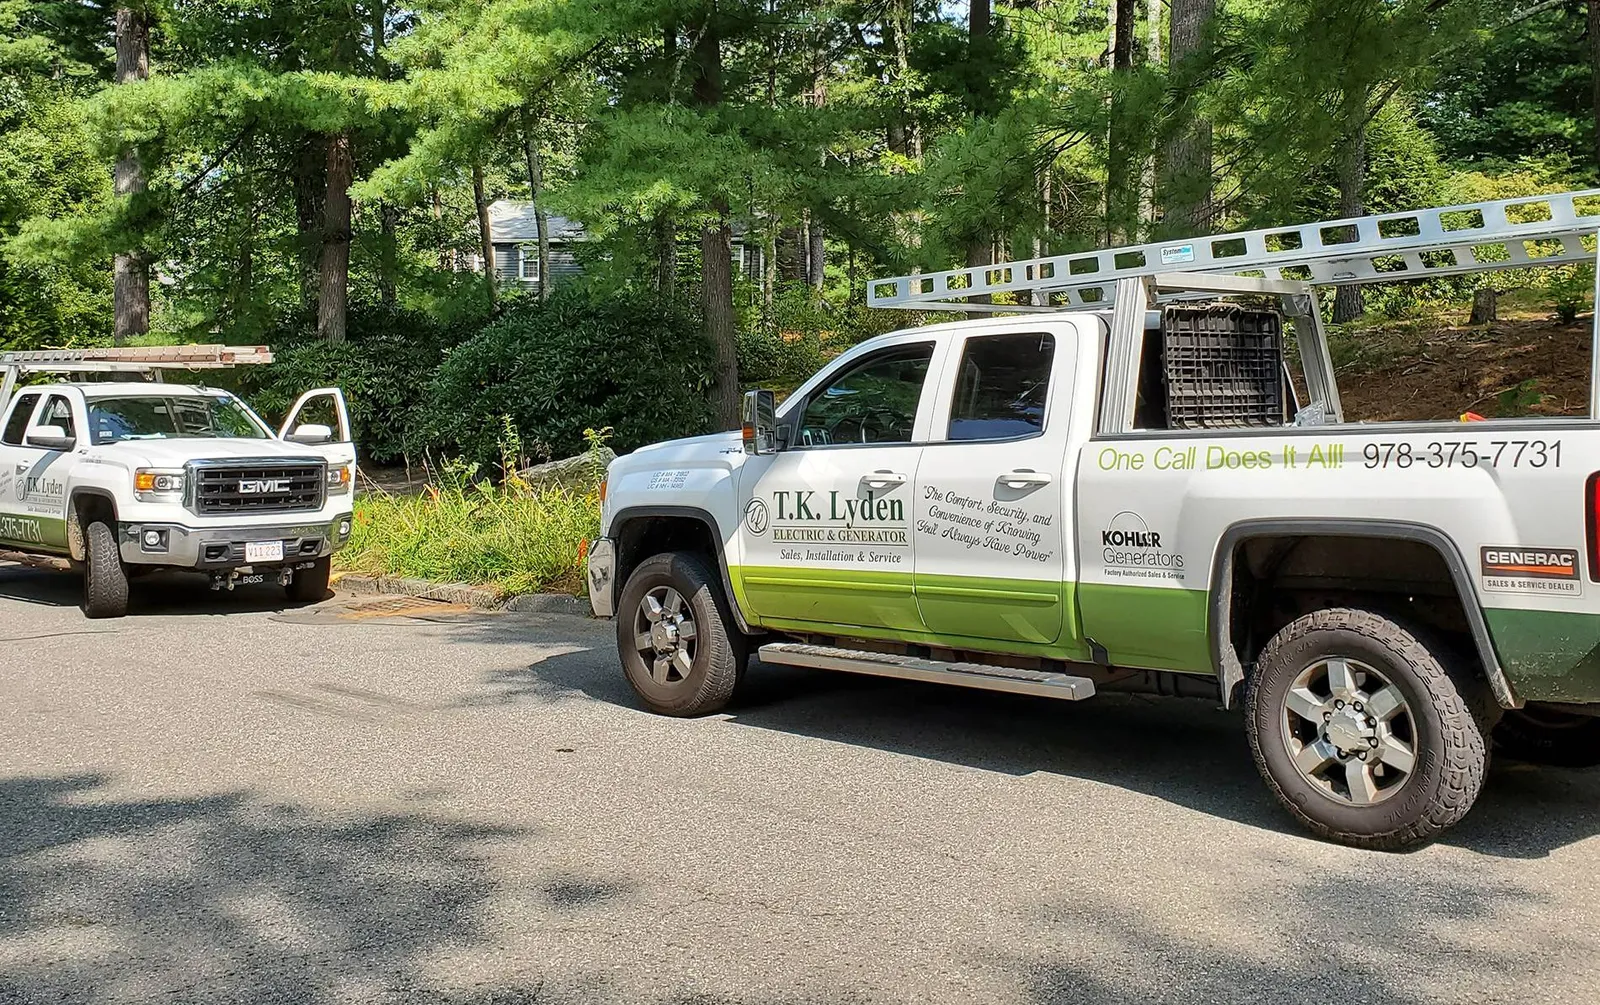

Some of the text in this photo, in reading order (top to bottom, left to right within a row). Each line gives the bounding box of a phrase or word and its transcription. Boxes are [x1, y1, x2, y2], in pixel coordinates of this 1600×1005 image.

[1099, 444, 1344, 470] One Call Does It All!
[1364, 440, 1562, 468] 978-375-7731
[42, 478, 62, 497] Lyden
[239, 480, 290, 493] GMC
[773, 491, 821, 520] T.K.
[829, 490, 904, 529] Lyden
[946, 491, 984, 512] Comfort,
[987, 501, 1029, 524] Security,
[1033, 514, 1052, 526] and
[929, 505, 1040, 546] Convenience of Knowing
[774, 530, 907, 542] ELECTRIC & GENERATOR
[941, 526, 981, 549] Always
[983, 536, 1010, 553] Have
[1102, 530, 1162, 547] KOHLER
[780, 549, 901, 563] Sales, Installation & Service
[1103, 547, 1184, 567] Generators
[1486, 551, 1572, 566] GENERAC
[243, 574, 263, 583] BOSS
[1518, 581, 1546, 589] SERVICE
